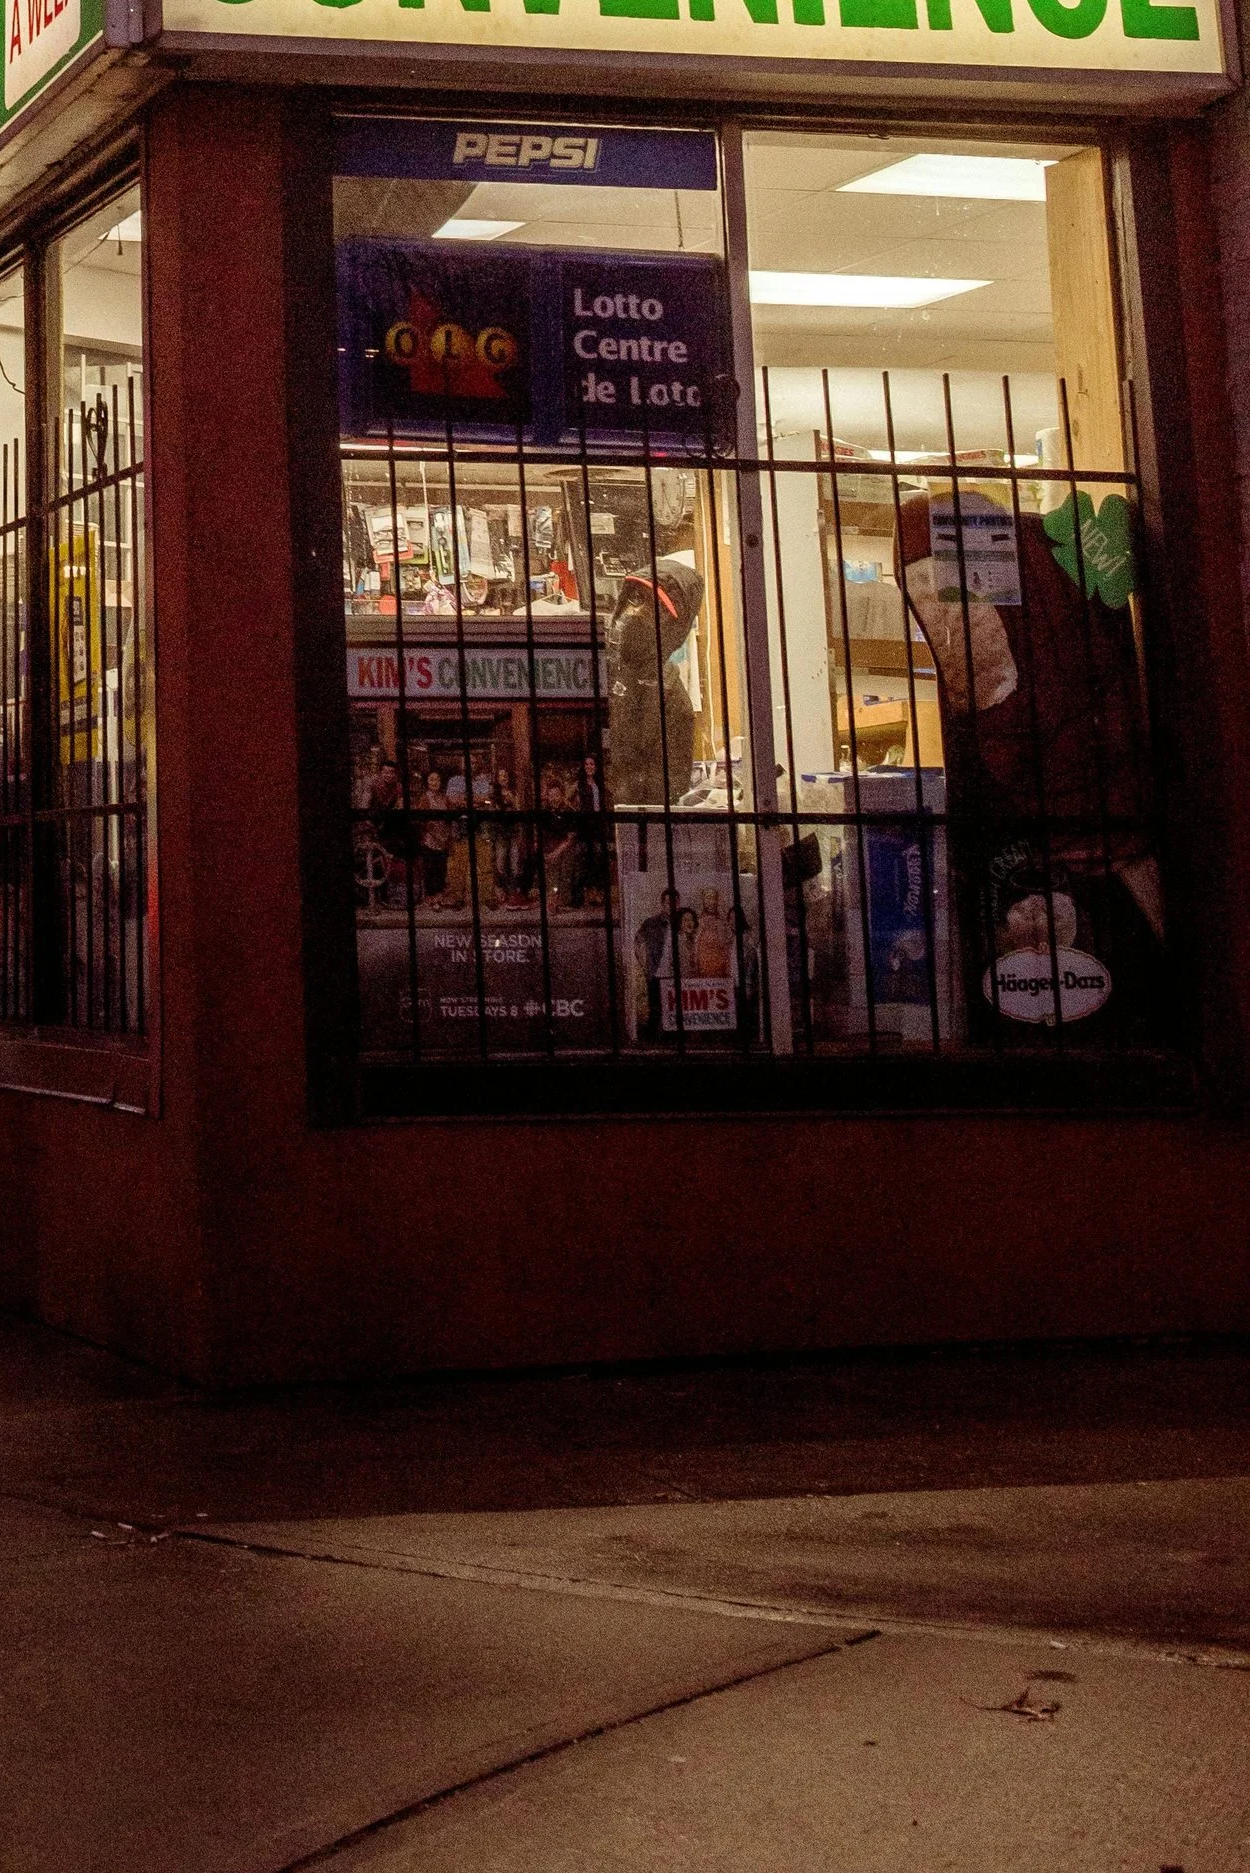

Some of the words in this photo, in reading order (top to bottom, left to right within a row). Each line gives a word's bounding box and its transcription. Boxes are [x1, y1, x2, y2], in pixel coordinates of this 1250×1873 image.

[453, 132, 600, 170] PEPSI
[573, 287, 664, 321] Lotto
[573, 329, 689, 364] Centre
[358, 657, 433, 689] KIM'S
[434, 934, 473, 948] NEW
[480, 934, 543, 948] SEASON
[451, 950, 467, 963] IN
